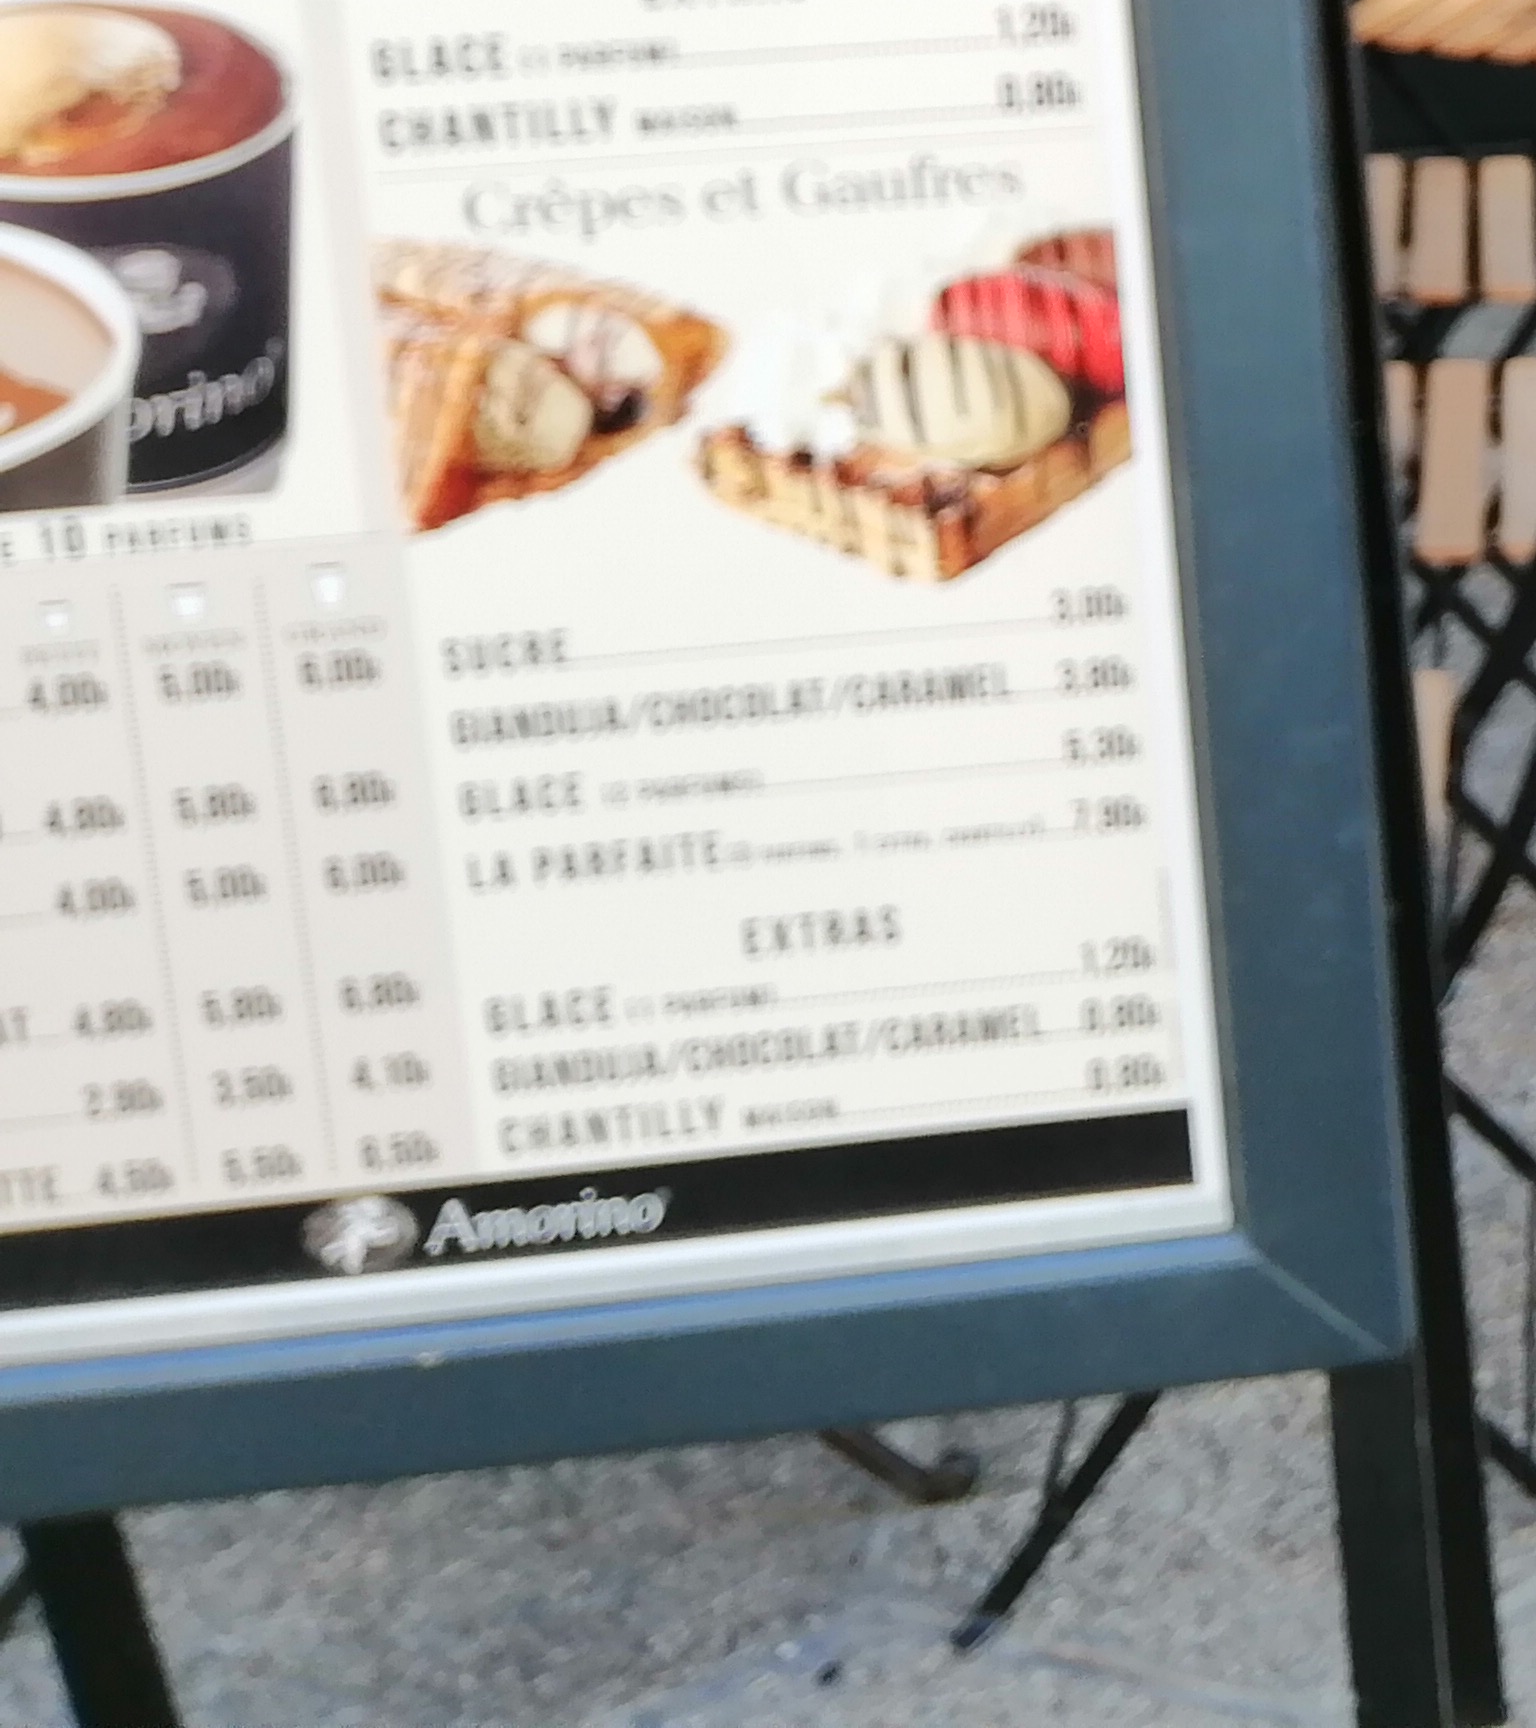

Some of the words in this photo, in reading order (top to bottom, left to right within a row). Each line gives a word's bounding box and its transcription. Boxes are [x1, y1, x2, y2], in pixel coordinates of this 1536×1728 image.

[369, 33, 509, 85] GLACE
[377, 97, 617, 156] CHANTILLY
[459, 177, 689, 244] Crêpes
[699, 167, 766, 223] et
[778, 152, 1026, 216] Gaufres
[128, 352, 280, 441] orino
[439, 629, 573, 682] SUCRE
[456, 772, 589, 825] GLACE
[462, 849, 520, 898] LA
[529, 831, 727, 891] PARFAITE
[737, 903, 903, 962] EXTRAS
[483, 985, 617, 1041] GLACE
[497, 1095, 723, 1160] CHANTILLY
[421, 1186, 672, 1257] Amorino
